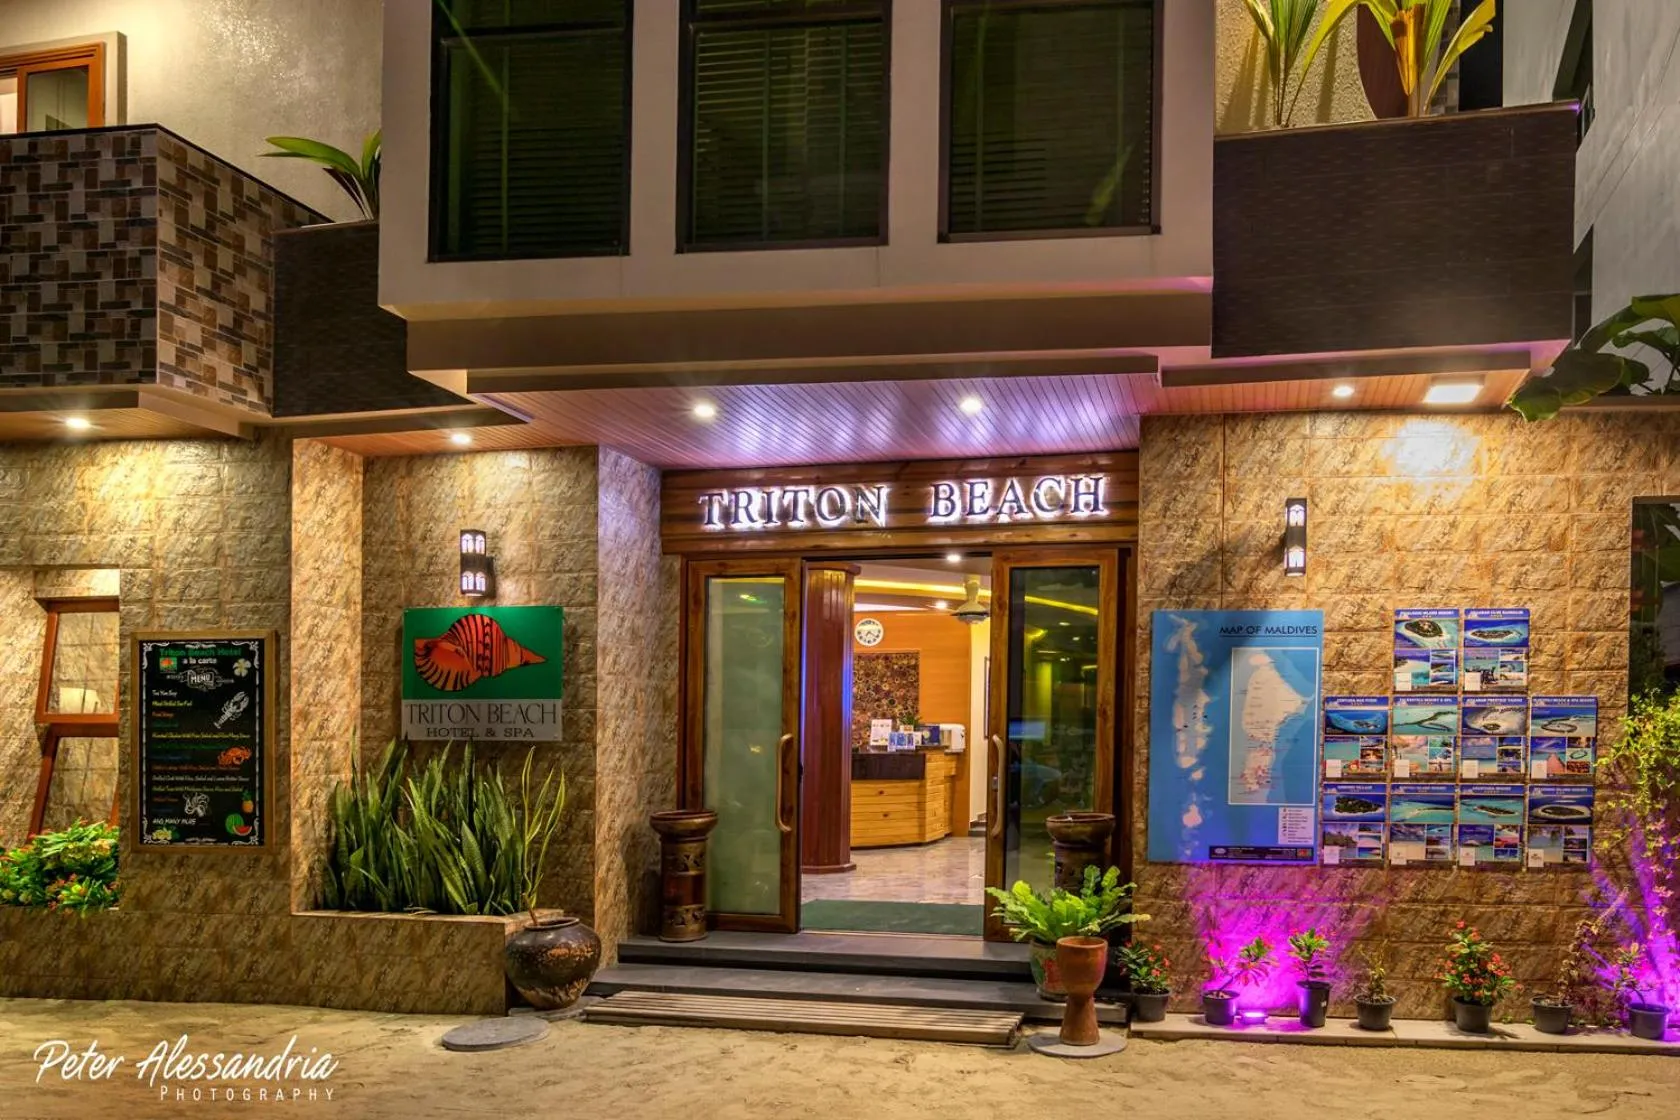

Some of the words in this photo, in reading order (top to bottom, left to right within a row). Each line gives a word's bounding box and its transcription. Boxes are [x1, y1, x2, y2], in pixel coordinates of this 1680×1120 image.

[699, 485, 889, 528] TRITON
[929, 474, 1107, 521] BEACH
[1219, 625, 1243, 635] MAP
[1246, 625, 1262, 635] OF
[1264, 625, 1318, 635] MALDIVES
[190, 674, 212, 684] MENU
[405, 703, 481, 725] TRITON
[487, 703, 557, 725] BEACH
[426, 727, 480, 738] HOTEL
[485, 728, 496, 738] &
[503, 727, 535, 738] SPA
